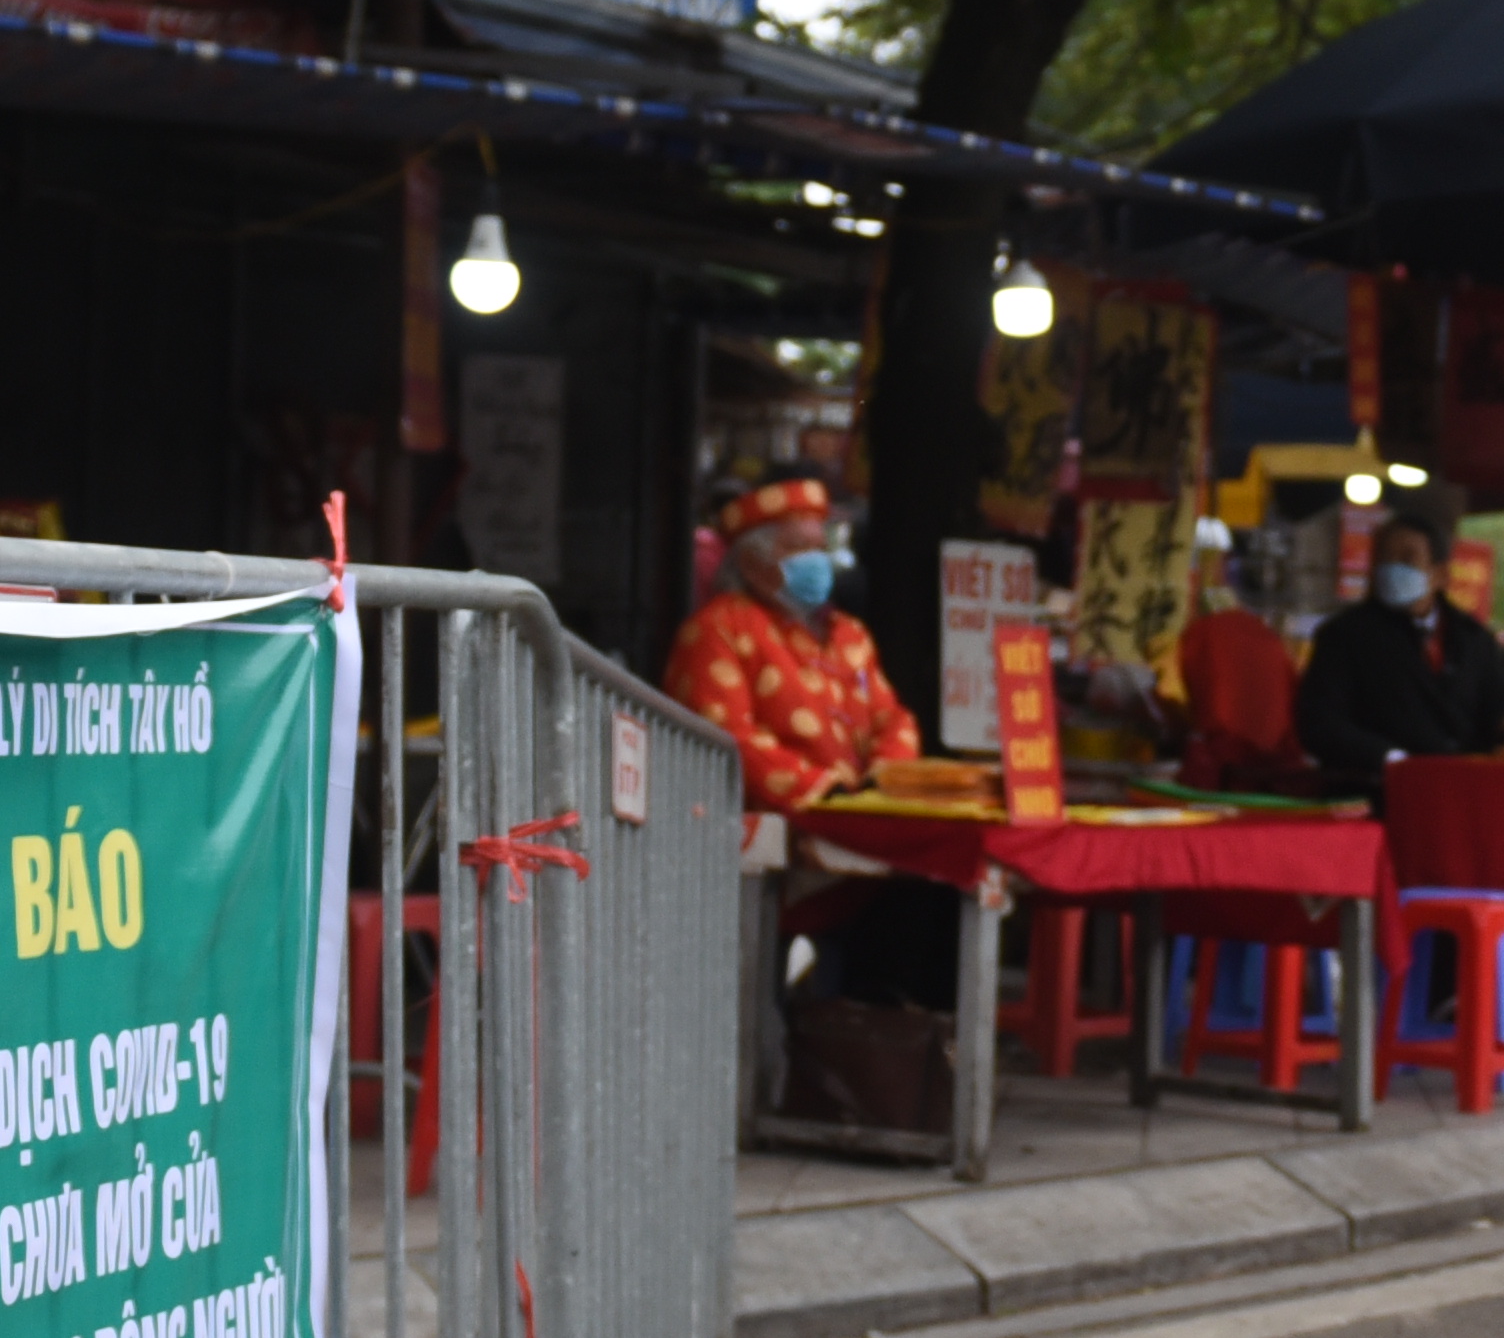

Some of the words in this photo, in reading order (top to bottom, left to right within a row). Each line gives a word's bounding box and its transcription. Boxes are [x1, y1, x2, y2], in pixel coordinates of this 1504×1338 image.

[33, 684, 57, 754] DI
[64, 670, 121, 754] TÍCH
[129, 670, 169, 752] TÂY
[174, 663, 211, 752] HỒ
[12, 806, 142, 958] BÁO
[90, 1014, 227, 1128] COVID-19
[0, 1183, 85, 1305] CHƯA
[97, 1143, 153, 1276] MỞ
[162, 1131, 220, 1258] CỬA
